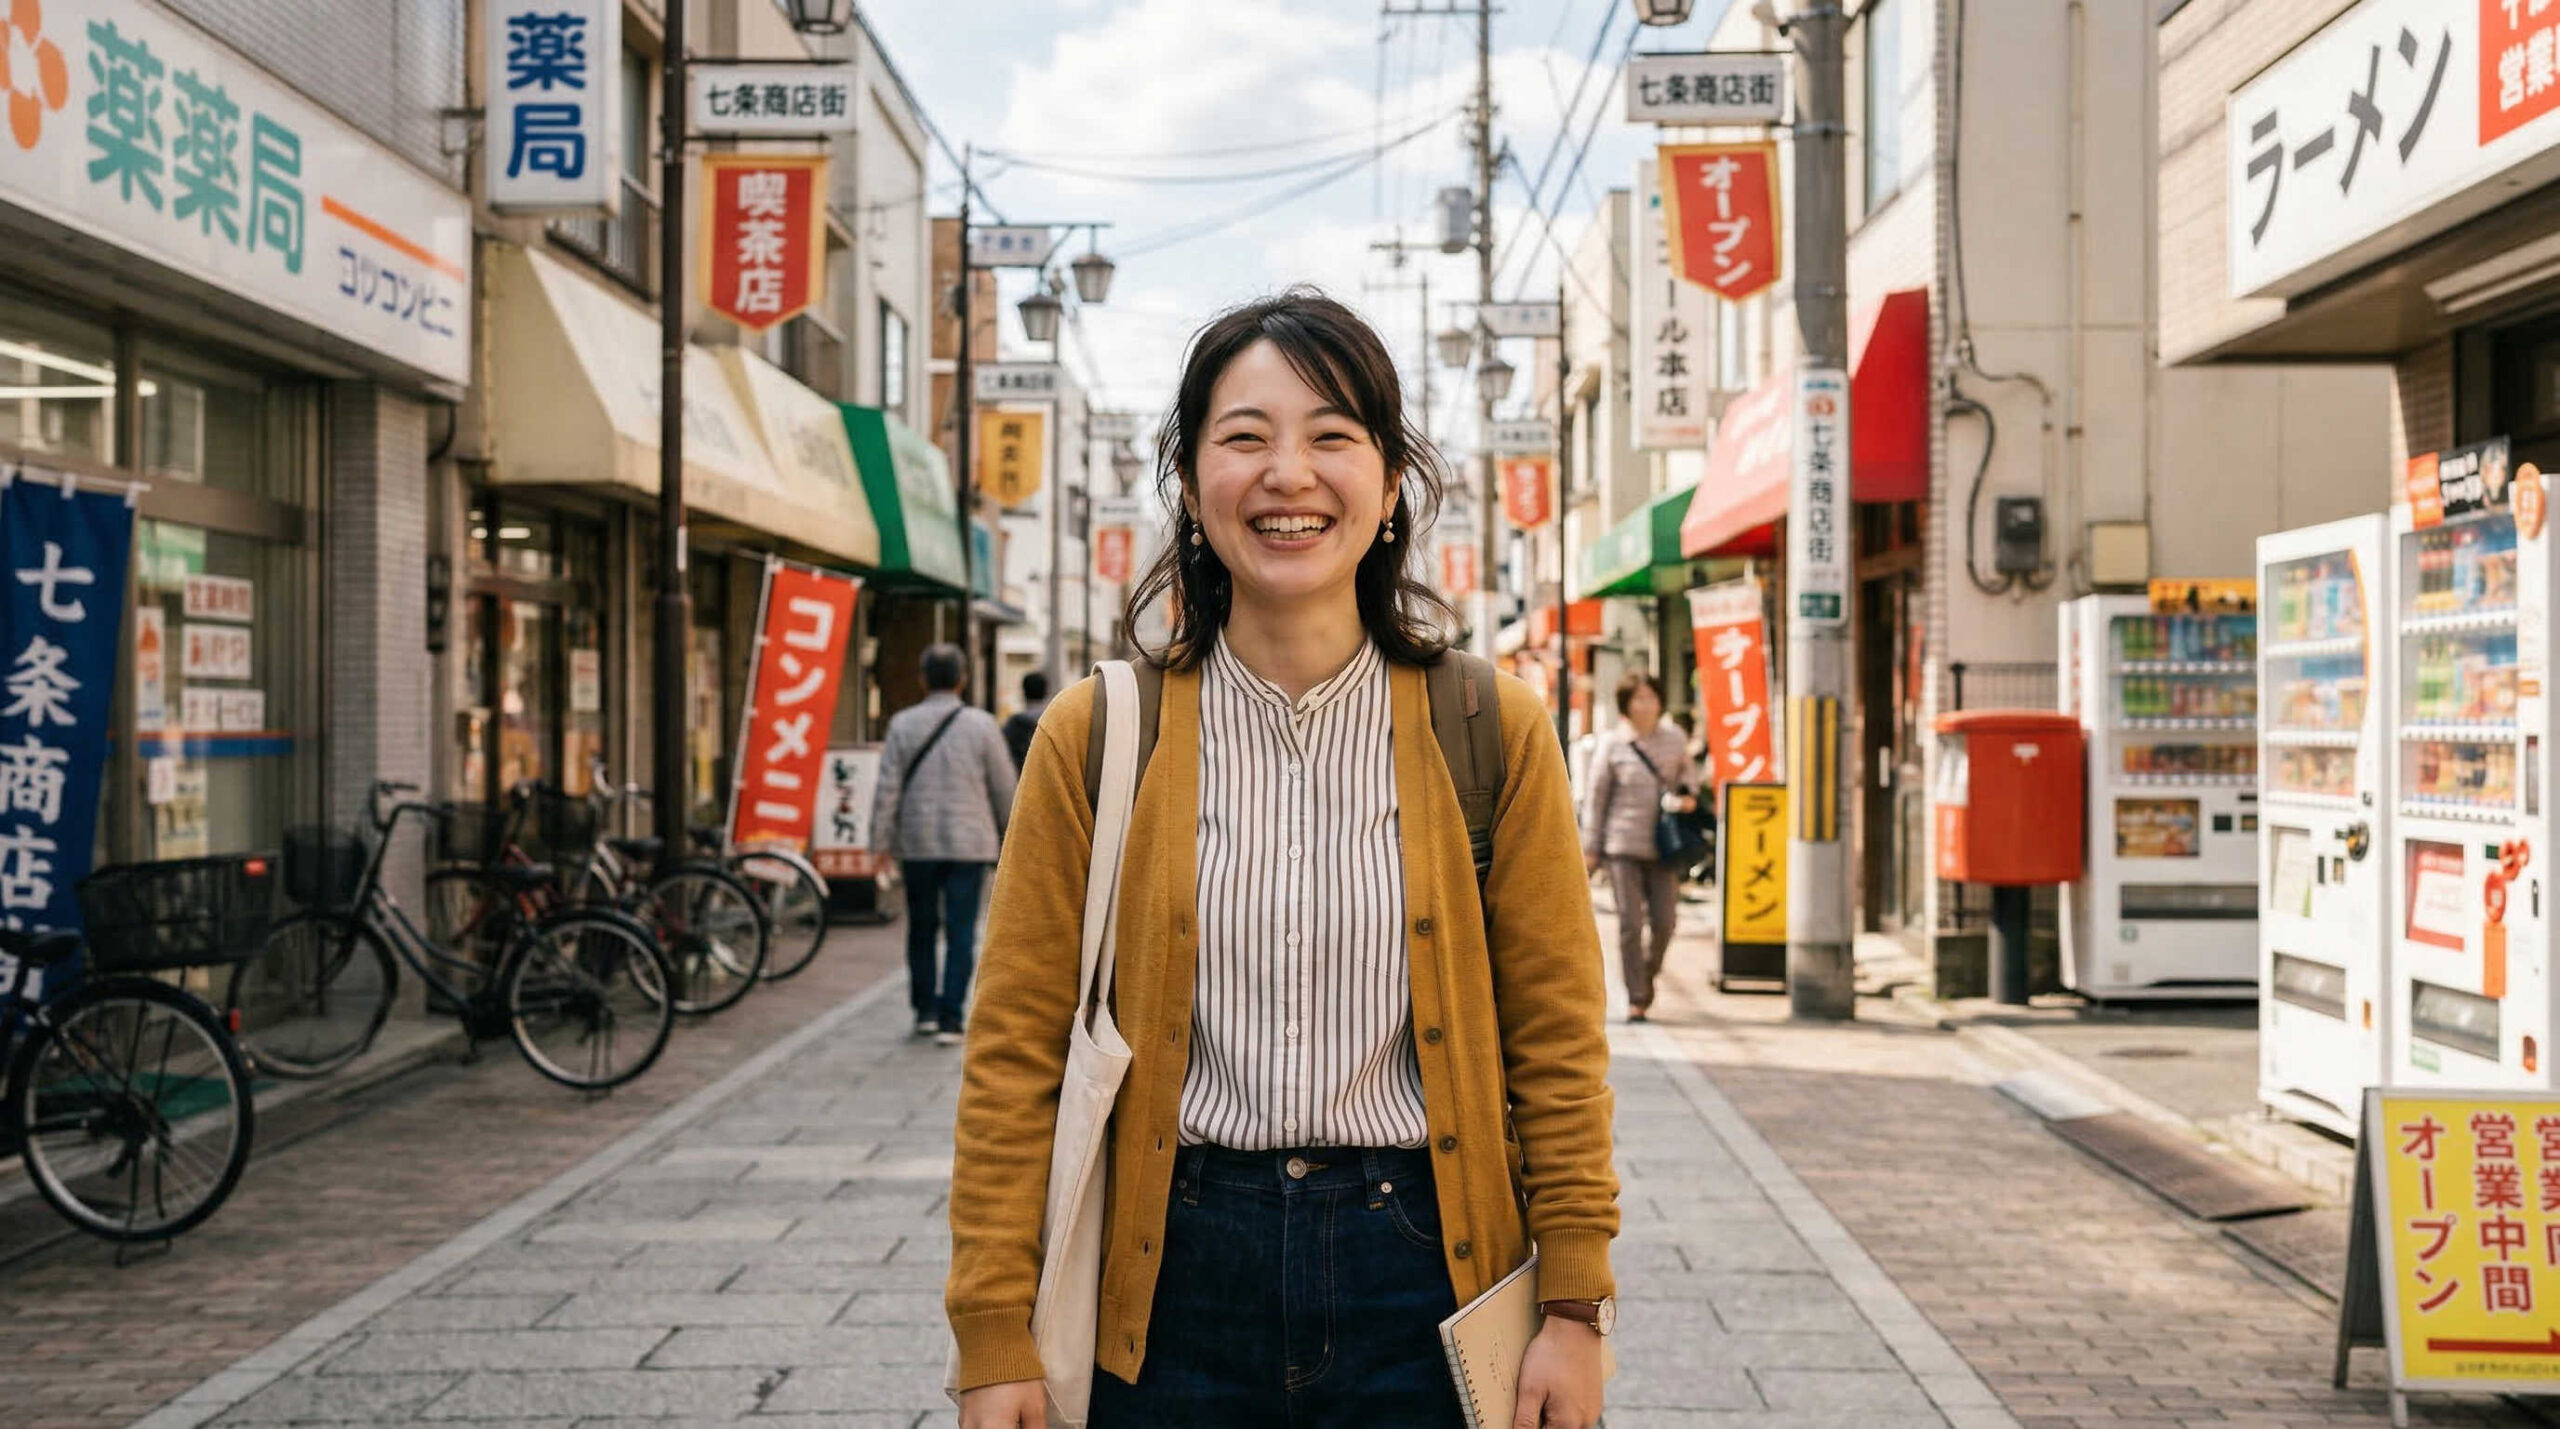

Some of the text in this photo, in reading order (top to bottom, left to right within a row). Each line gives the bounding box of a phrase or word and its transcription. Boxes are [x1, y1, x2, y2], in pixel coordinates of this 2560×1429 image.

[86, 19, 304, 274] 薬薬局
[507, 13, 587, 179] 薬局
[707, 83, 847, 117] 七条商店街
[1640, 74, 1775, 106] 七条商店街
[2247, 26, 2451, 249] ラーメン
[2498, 23, 2560, 111] 営業
[735, 170, 788, 314] 喫茶店
[0, 541, 95, 998] 七条商店
[754, 596, 834, 822] コンメニ
[1745, 794, 1779, 922] ラーメン
[2400, 1115, 2459, 1312] オープン
[2470, 1113, 2531, 1312] 営業中間
